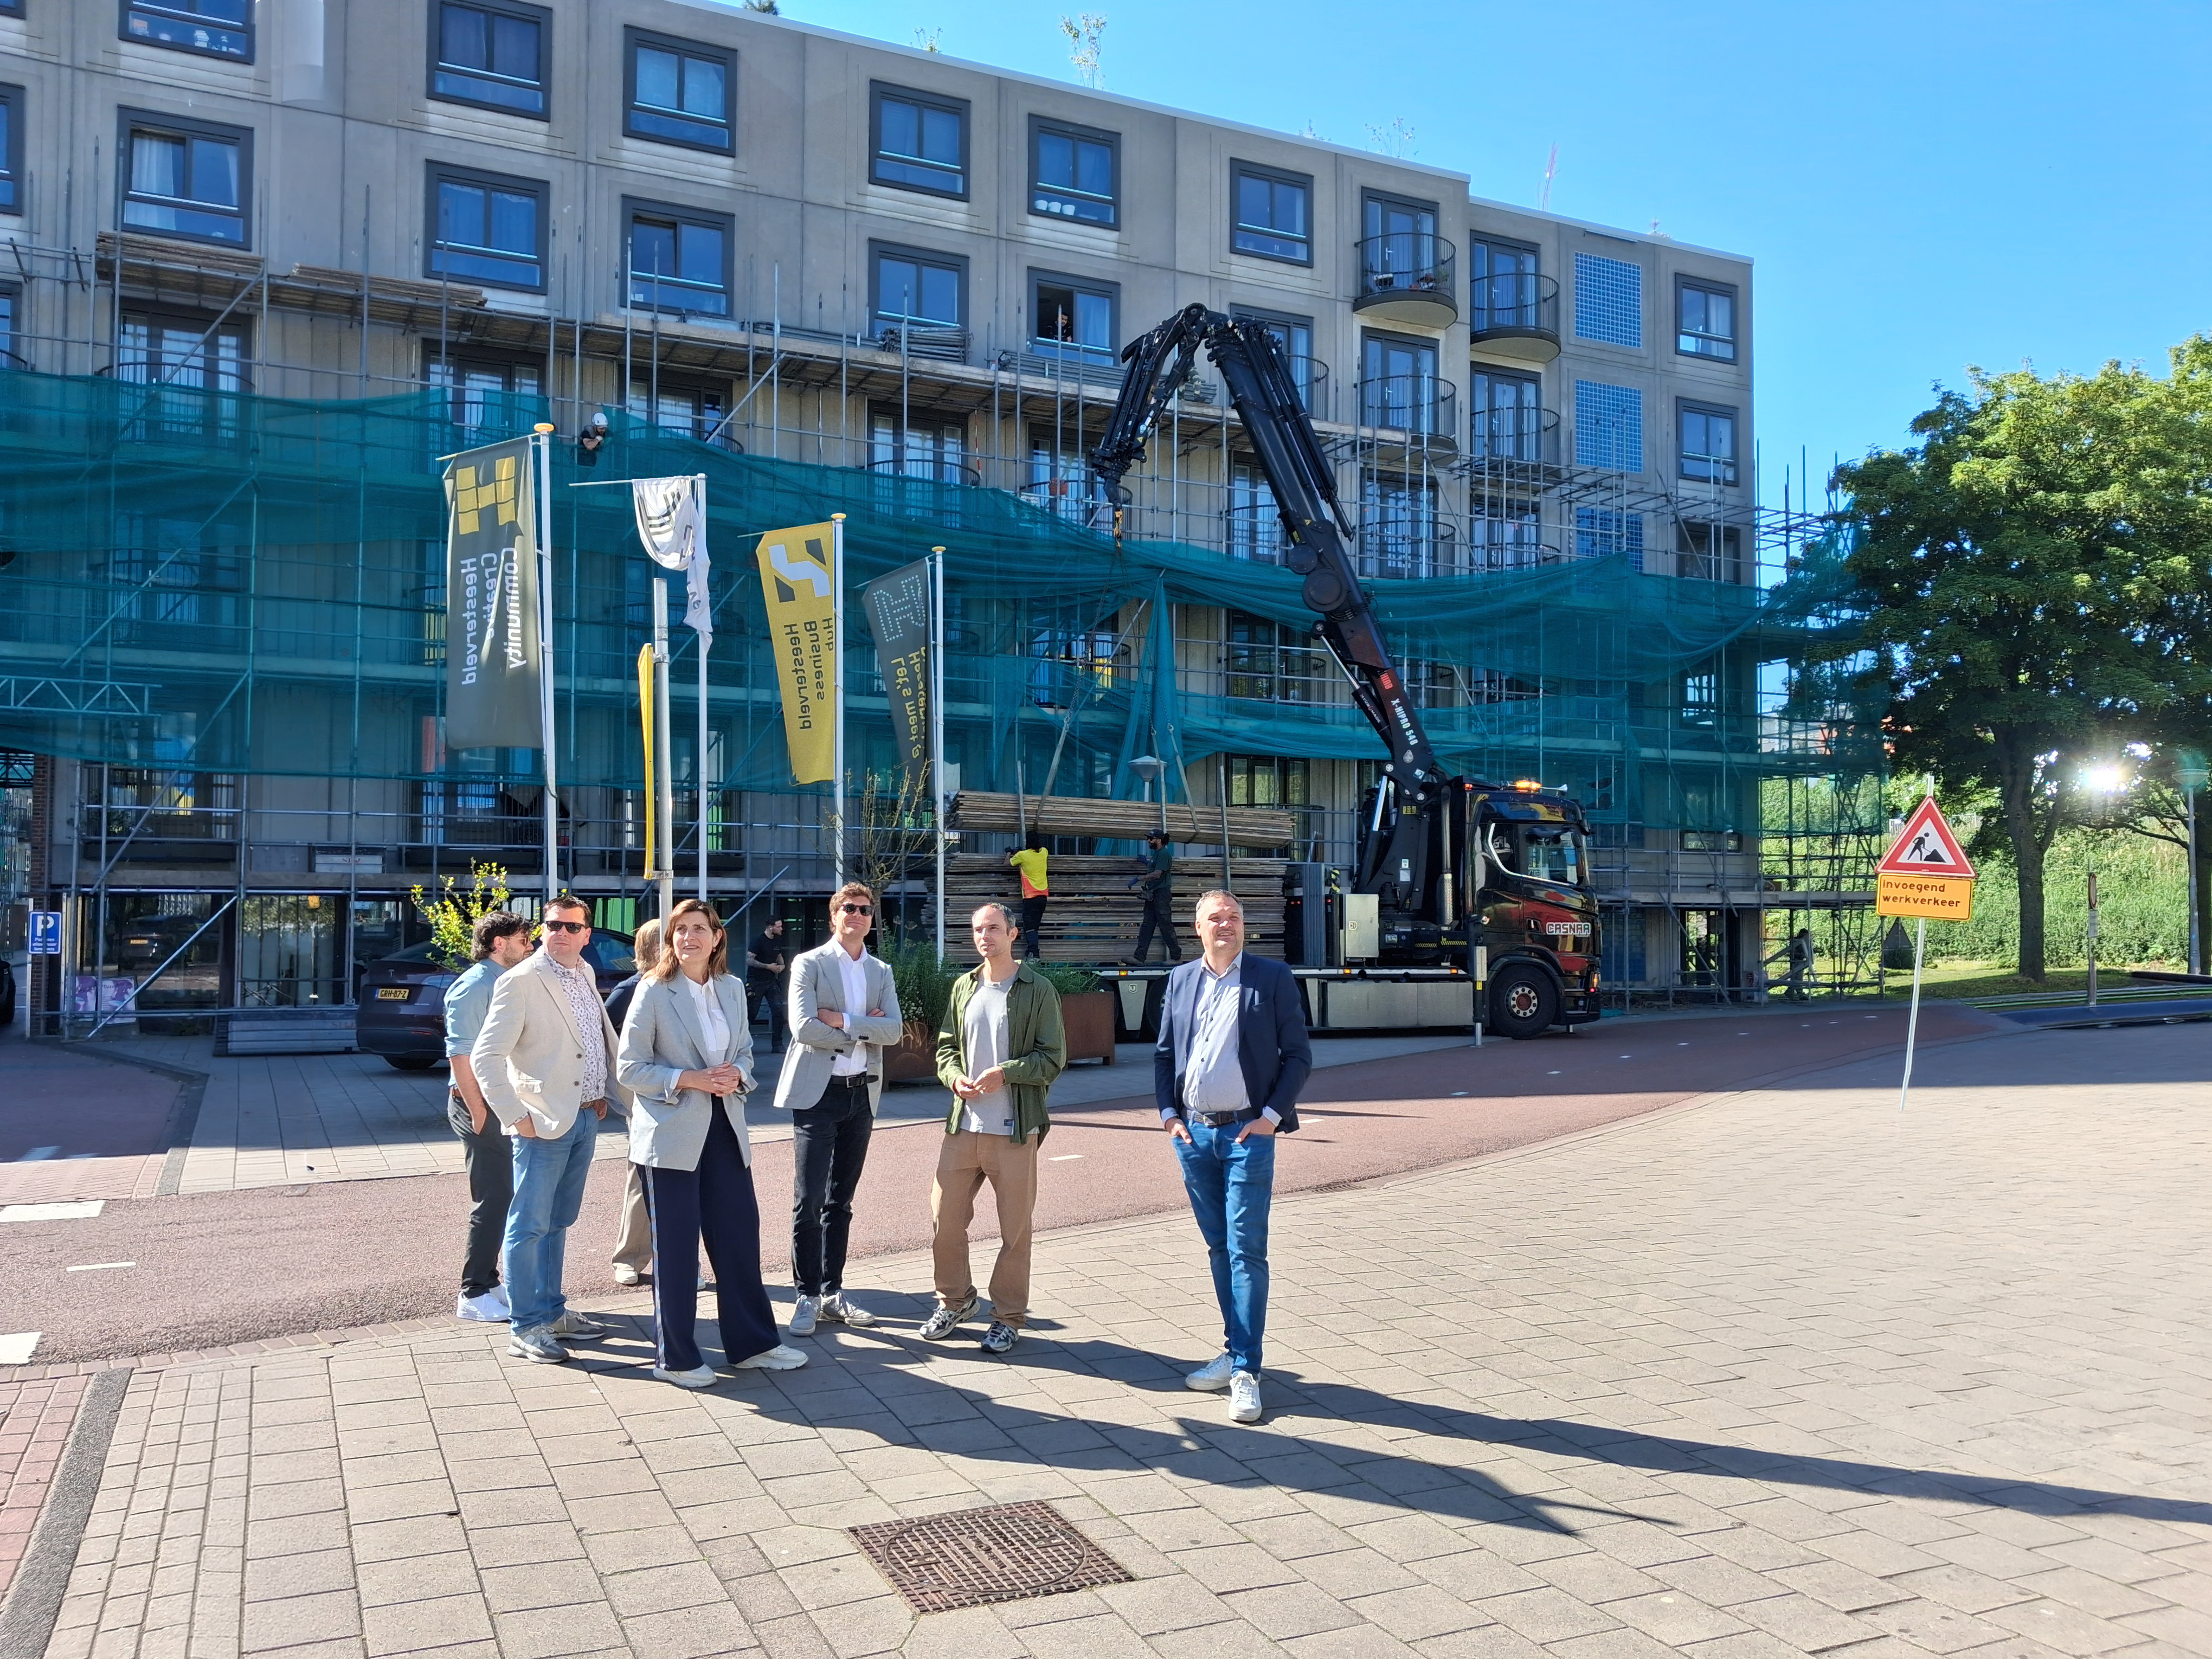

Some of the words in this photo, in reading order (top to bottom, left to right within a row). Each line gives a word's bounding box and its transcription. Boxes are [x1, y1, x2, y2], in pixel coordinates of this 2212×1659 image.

[1380, 672, 1393, 690] HIAB
[1391, 698, 1411, 729] X-HIPRO
[1405, 729, 1418, 745] 548
[1882, 879, 1945, 893] Invoegend
[1882, 895, 1961, 908] werkverkeer
[37, 915, 54, 936] P
[380, 989, 407, 998] GRH-87-Z
